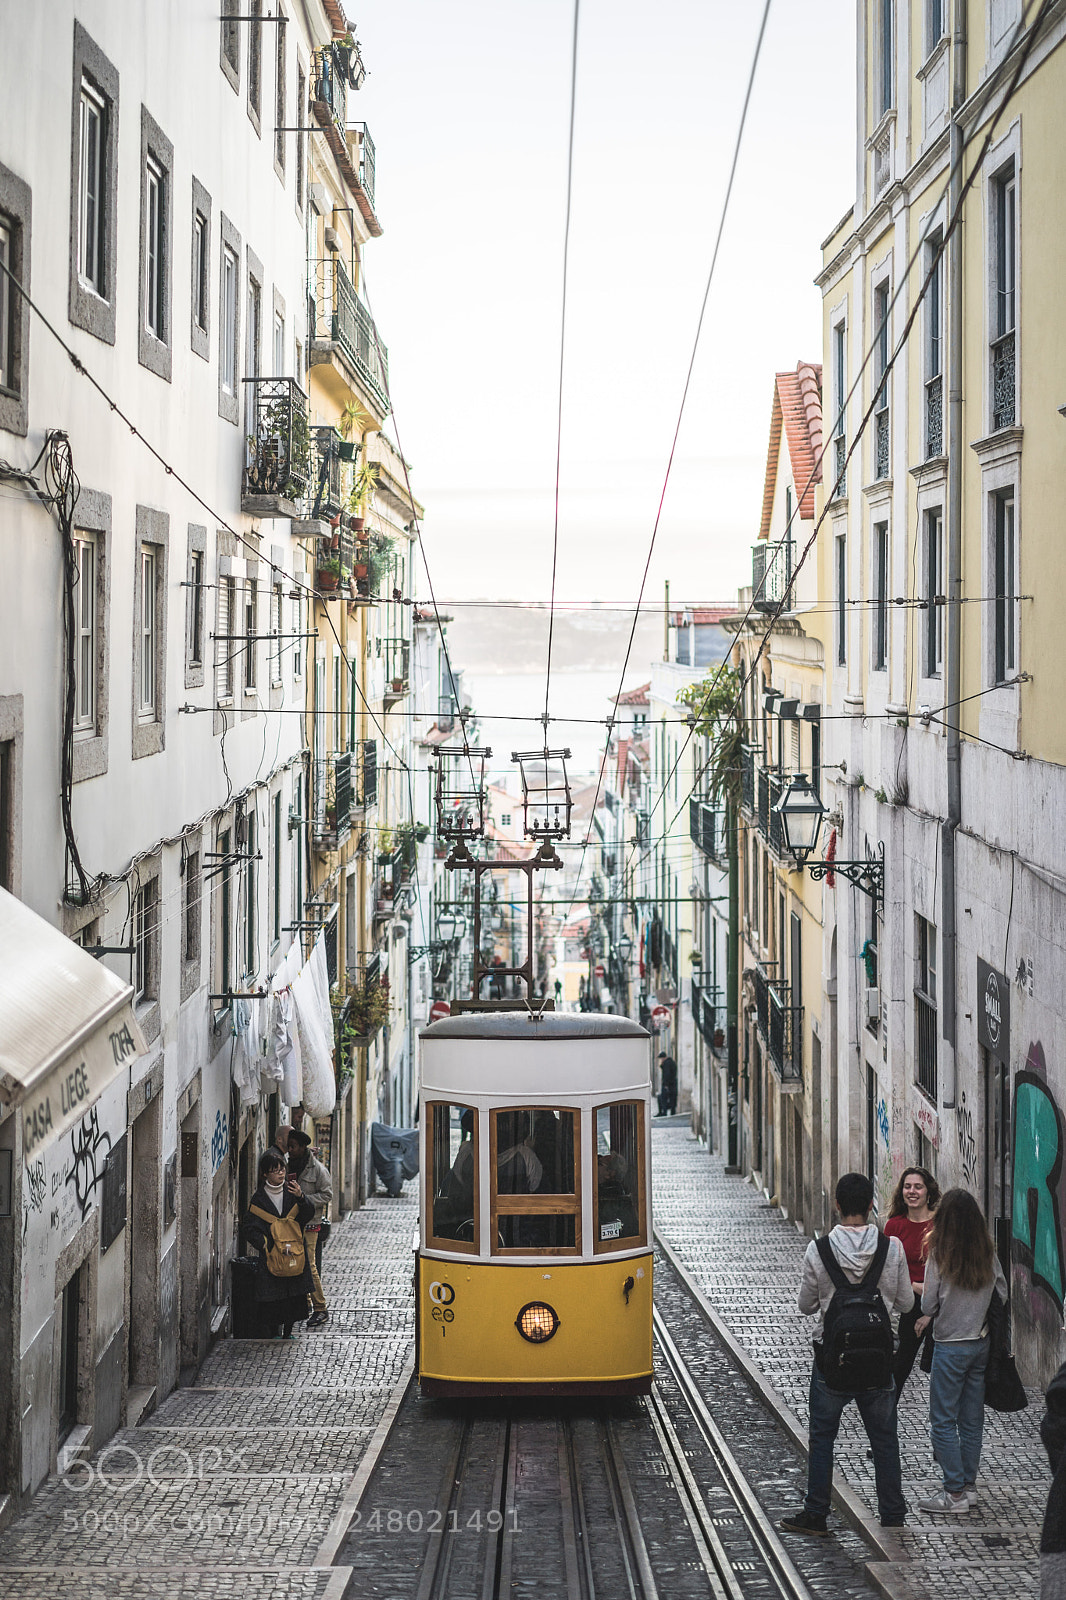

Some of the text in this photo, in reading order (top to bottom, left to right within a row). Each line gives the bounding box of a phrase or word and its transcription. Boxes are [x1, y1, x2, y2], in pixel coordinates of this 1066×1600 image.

[985, 991, 1001, 1024] SMALL
[24, 1062, 90, 1153] CASA LIEGE
[441, 1325, 446, 1338] 1
